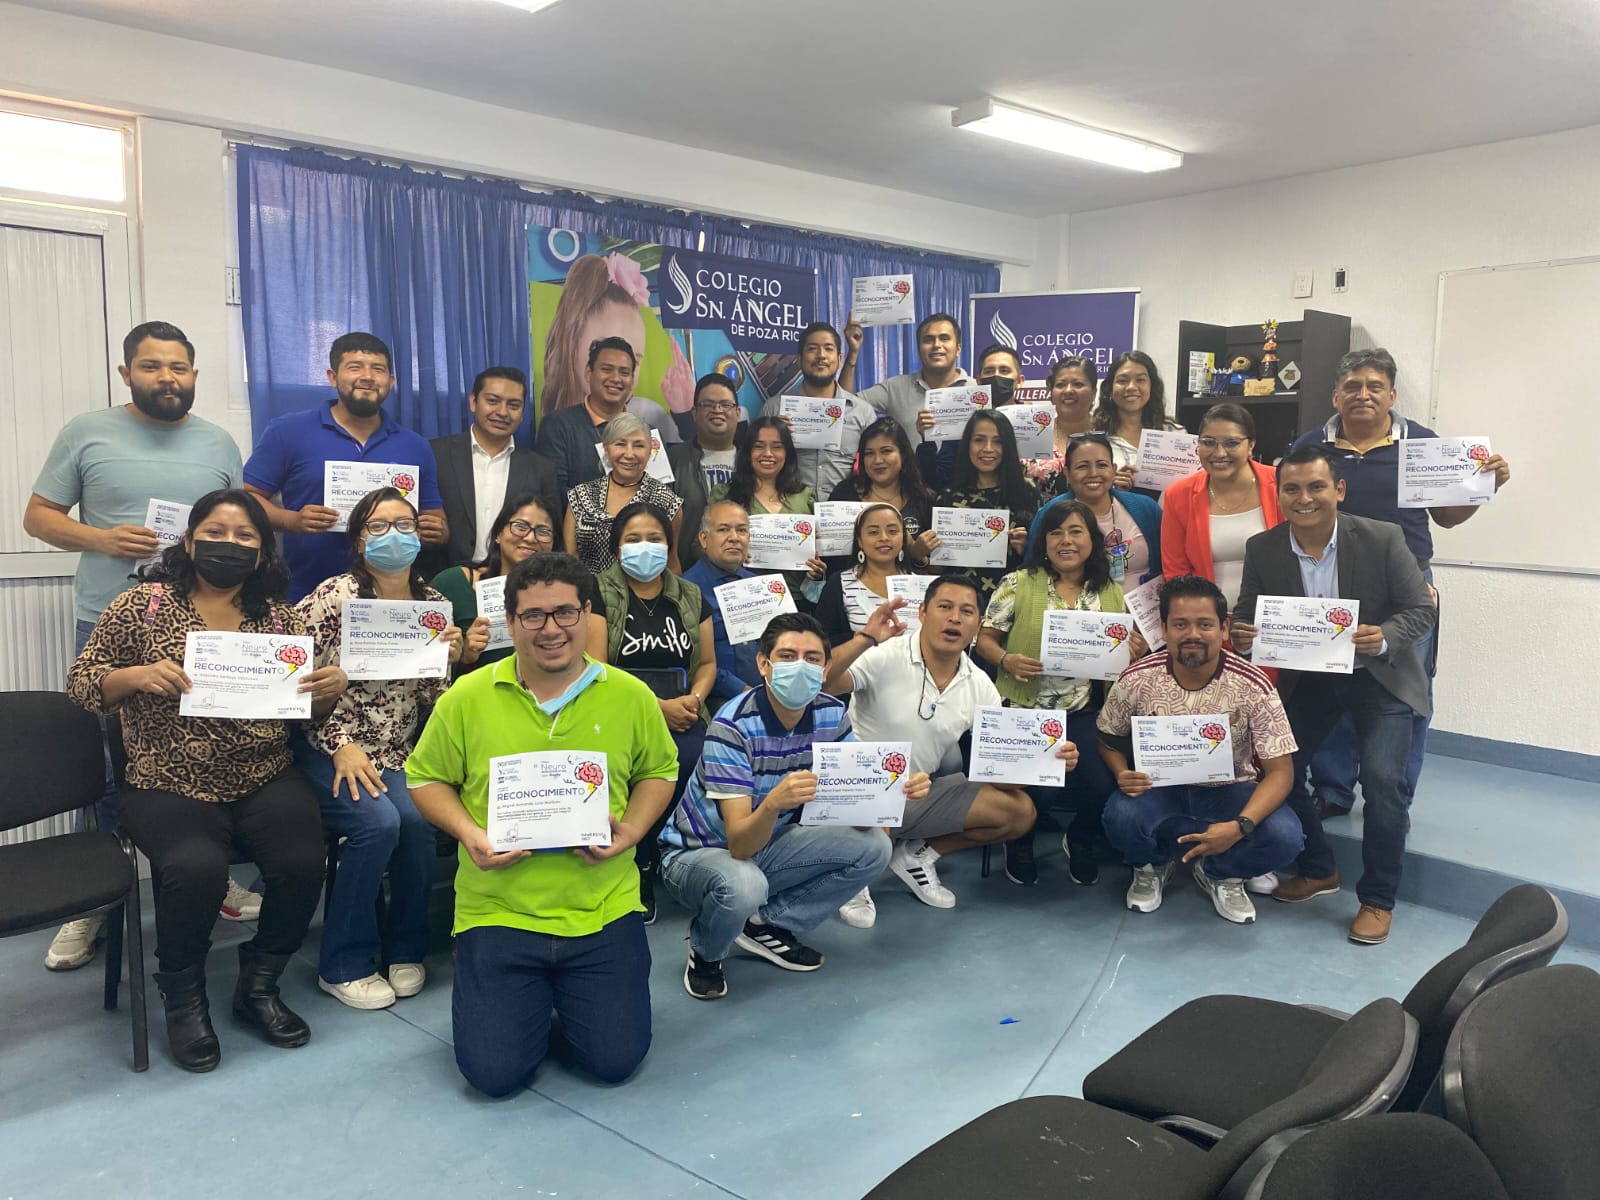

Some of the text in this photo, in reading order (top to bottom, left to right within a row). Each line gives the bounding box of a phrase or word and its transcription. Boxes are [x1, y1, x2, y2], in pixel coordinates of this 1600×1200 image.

[696, 269, 782, 297] COLEGIO
[731, 292, 808, 329] ÁNGEL
[731, 324, 800, 342] DE POZA RIC
[1022, 333, 1094, 347] COLEGIO
[1013, 388, 1052, 400] ILLERA
[1142, 453, 1201, 466] RECONOCIMIENTO
[1406, 464, 1475, 473] RECONOCIMIENTO
[1262, 623, 1334, 634] RECONOCIMIENTO
[350, 631, 428, 640] RECONOCIMIENTO
[622, 614, 691, 658] Smile
[1048, 637, 1112, 648] RECONOCIMIENTO
[194, 662, 285, 675] RECONOCIMIENTO
[979, 736, 1048, 747] RECONOCIMIENTO
[1139, 743, 1210, 752] RECONOCIMIENTO
[818, 777, 889, 786] RECONOCIMIENTO
[497, 787, 586, 801] RECONOCIMIENTO
